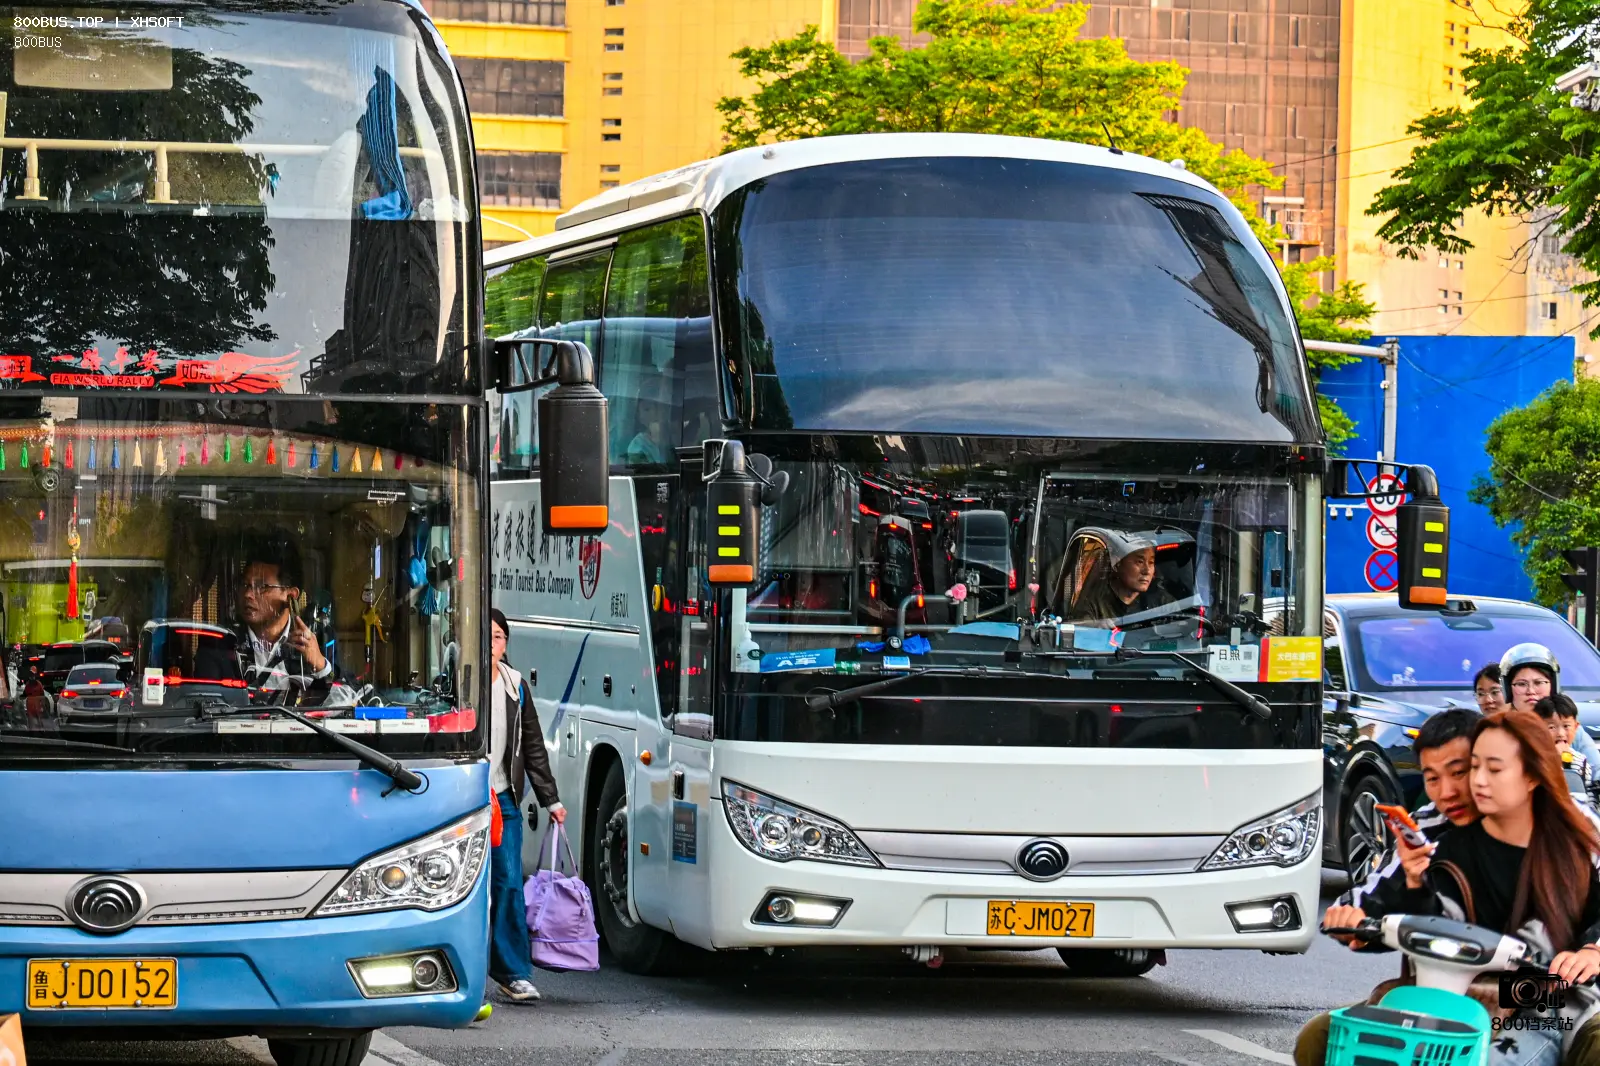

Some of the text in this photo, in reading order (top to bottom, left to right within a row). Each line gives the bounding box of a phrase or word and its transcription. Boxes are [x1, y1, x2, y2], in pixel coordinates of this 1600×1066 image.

[53, 375, 152, 385] FIA WORLD RALLY
[499, 567, 514, 591] Affair
[516, 568, 534, 593] Tourist
[536, 570, 546, 593] Bus
[548, 570, 575, 600] Company
[1219, 649, 1241, 661] 日照
